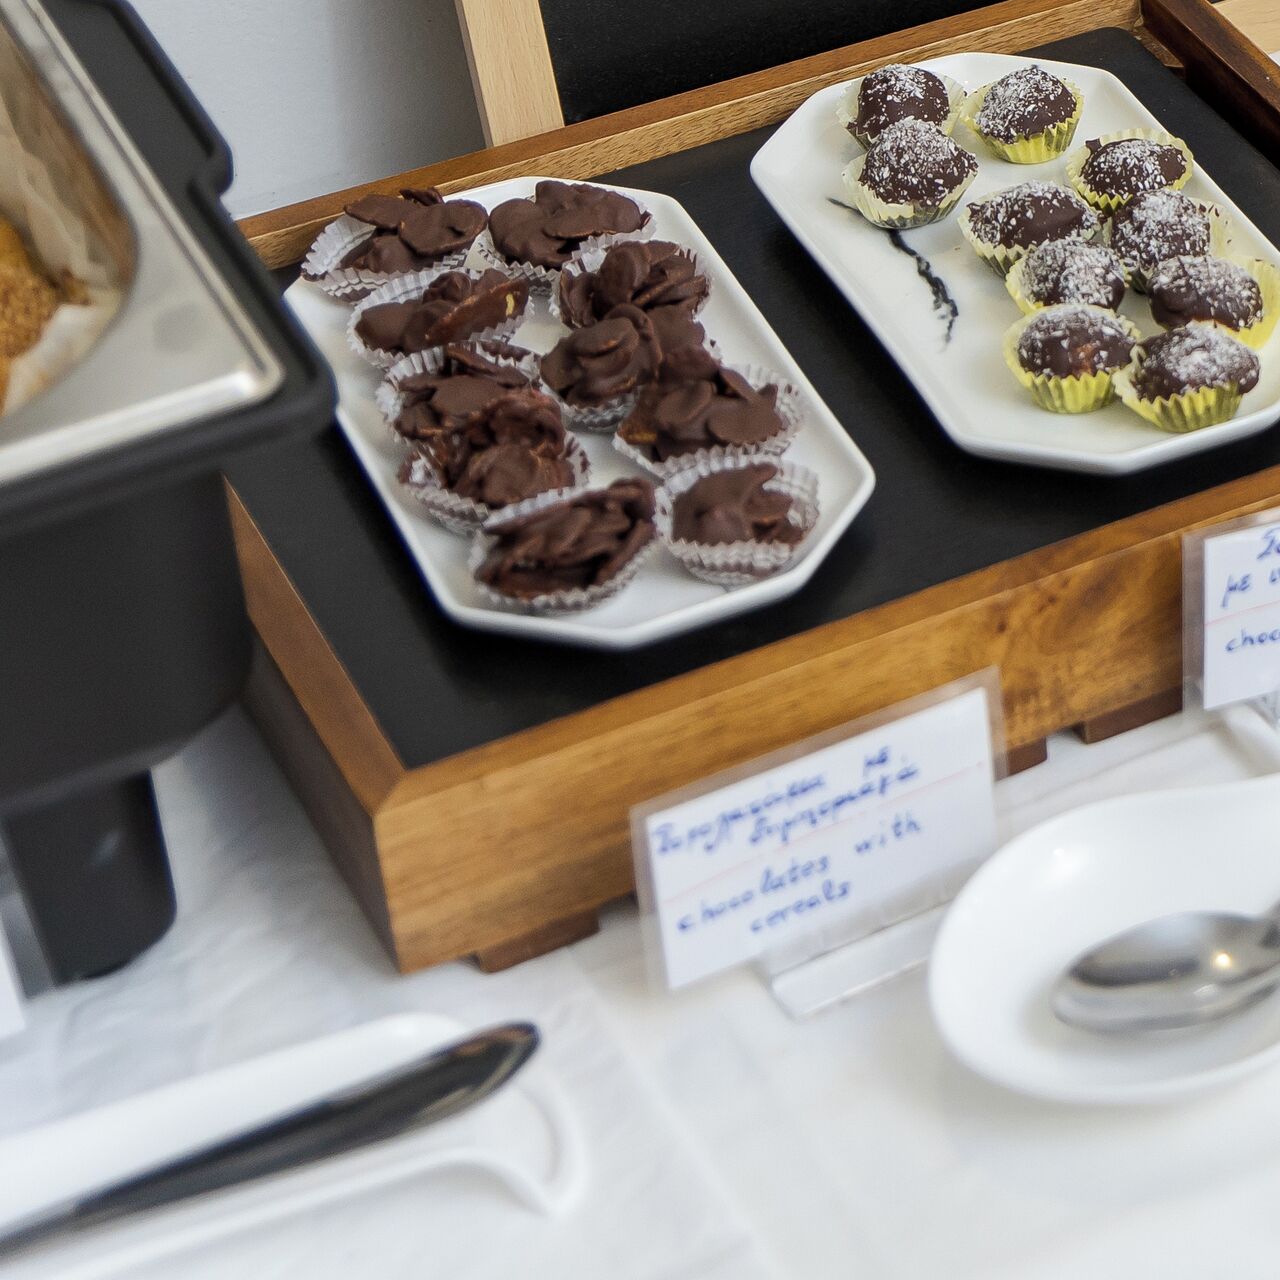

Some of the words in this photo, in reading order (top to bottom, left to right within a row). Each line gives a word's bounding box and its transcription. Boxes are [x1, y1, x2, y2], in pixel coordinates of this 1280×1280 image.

[1220, 573, 1252, 608] με
[677, 855, 830, 932] chocolates
[855, 812, 922, 854] with
[751, 879, 851, 933] cereals
